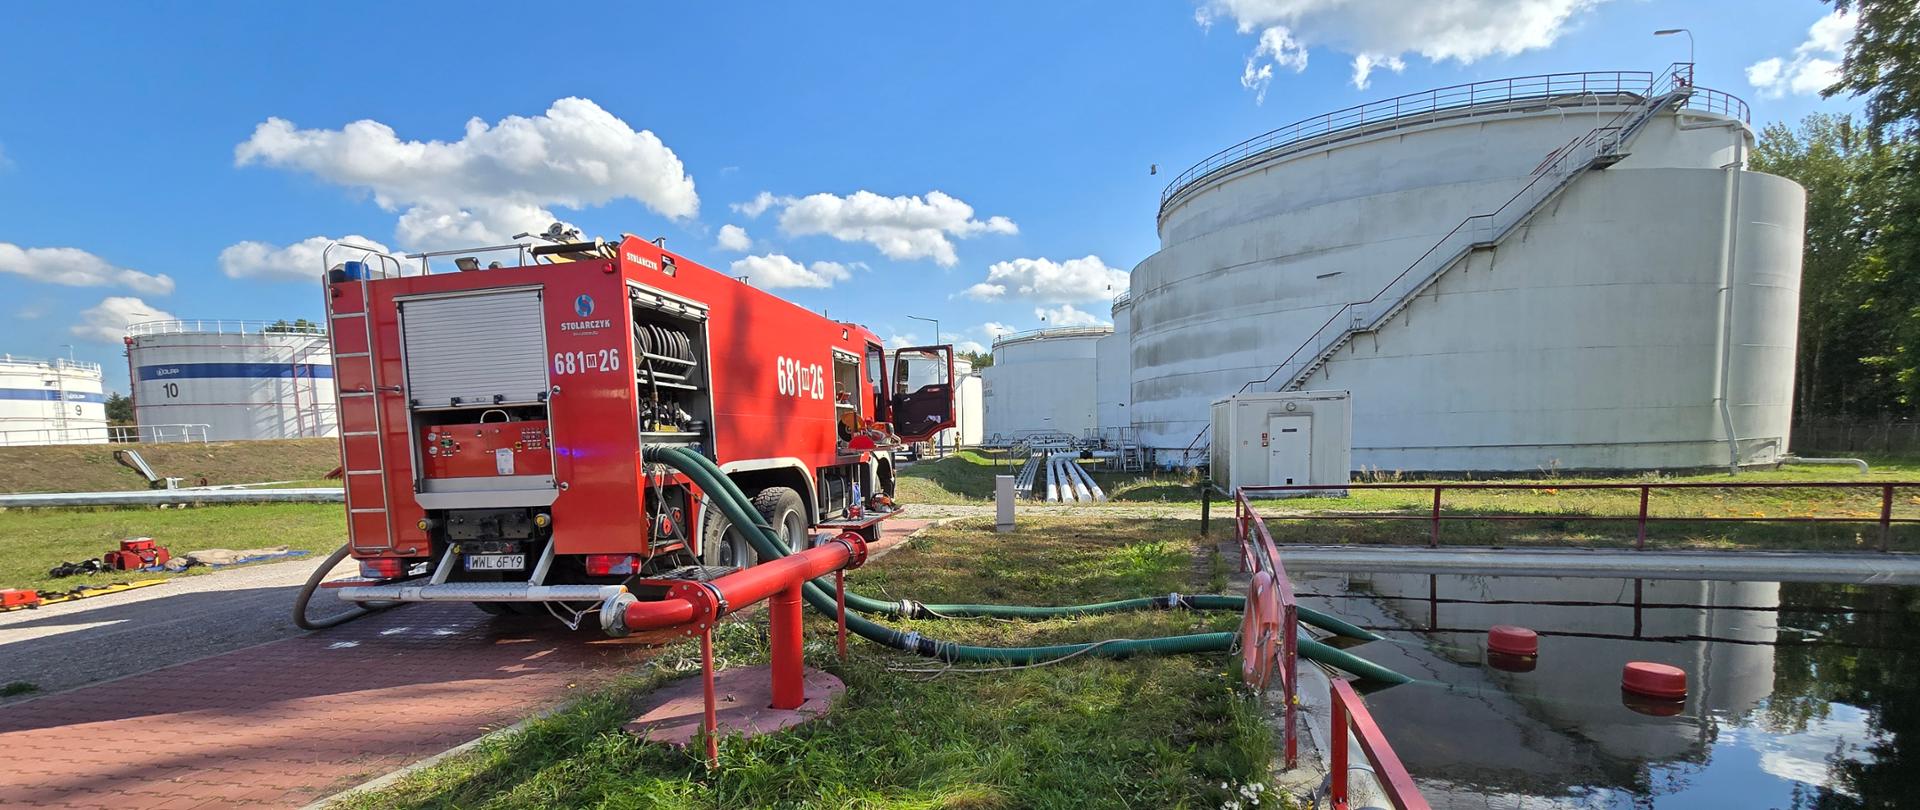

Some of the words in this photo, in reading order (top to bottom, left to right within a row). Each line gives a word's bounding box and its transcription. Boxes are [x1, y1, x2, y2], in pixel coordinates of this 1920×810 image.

[560, 320, 611, 331] STOLARCZYK
[599, 348, 620, 372] 26
[810, 363, 824, 400] 26
[162, 383, 179, 398] 10
[75, 404, 82, 416] 9
[471, 556, 493, 568] WWL
[496, 556, 523, 568] 6FY9
